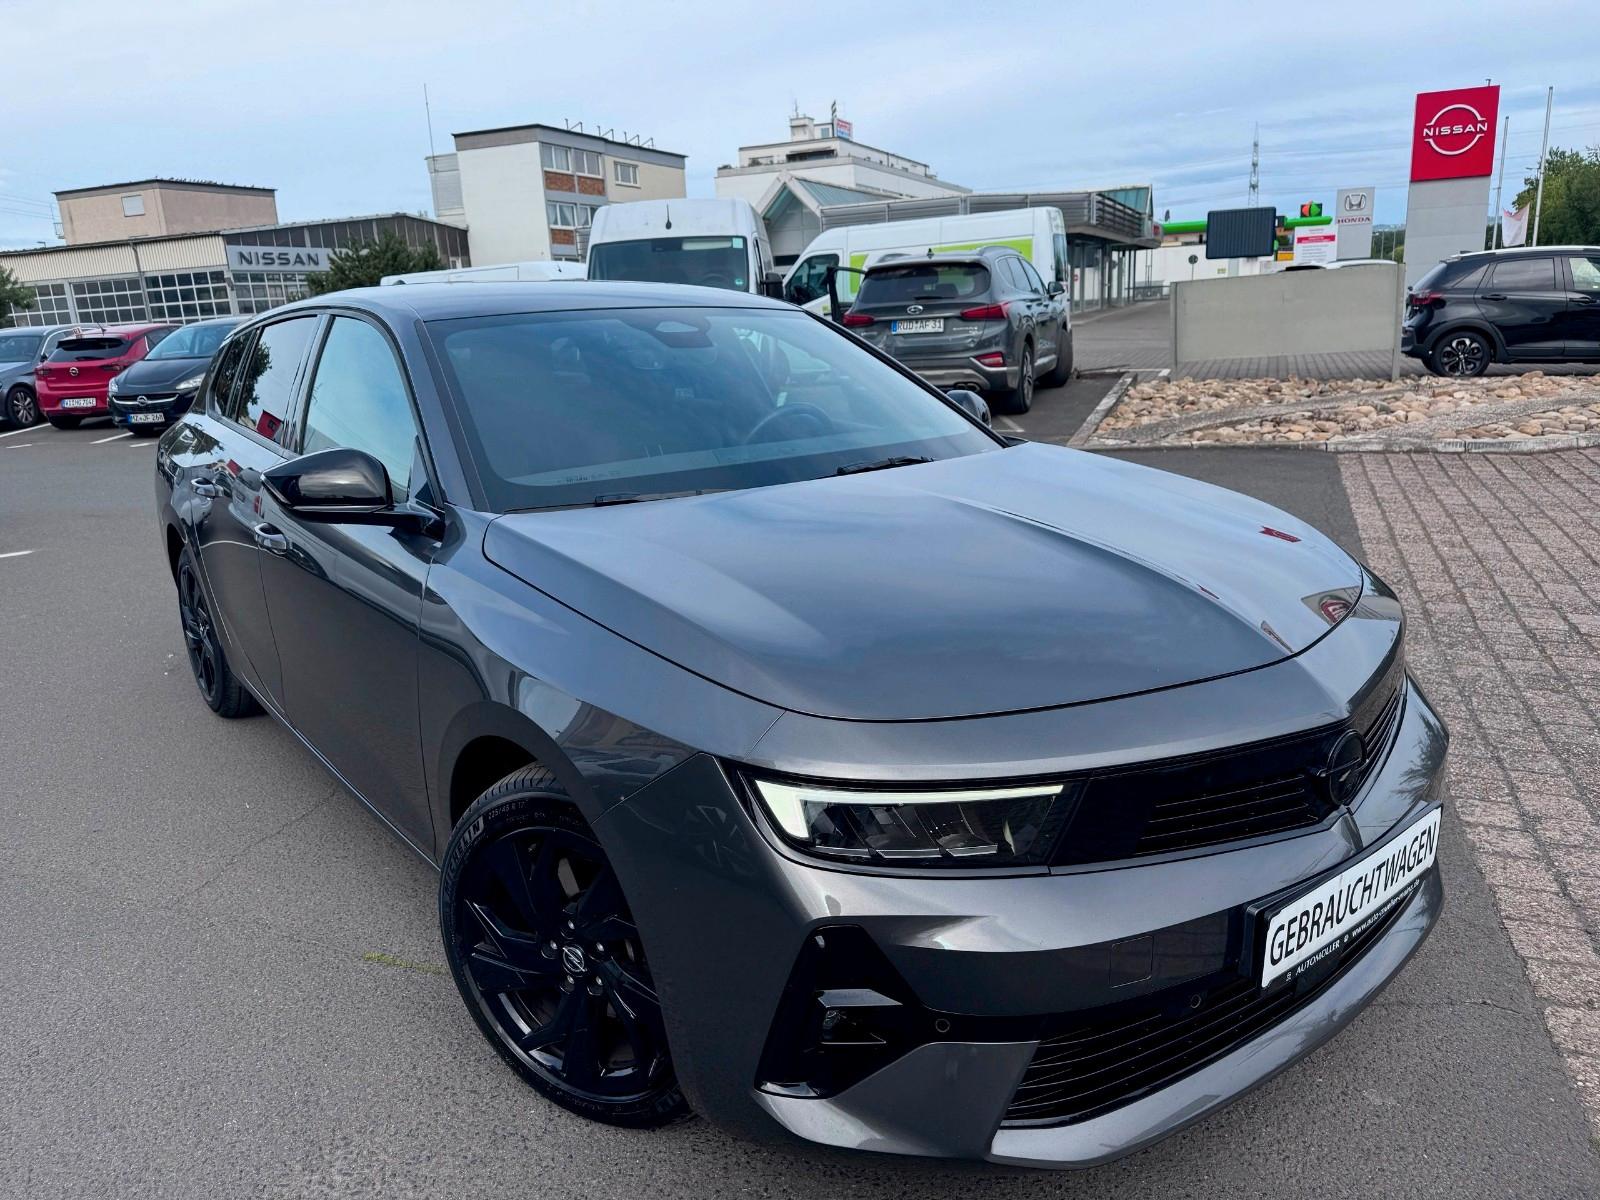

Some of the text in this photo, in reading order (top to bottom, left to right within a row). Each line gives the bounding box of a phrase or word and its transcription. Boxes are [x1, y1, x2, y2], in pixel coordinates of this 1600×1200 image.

[1422, 122, 1488, 137] NISSAN
[1336, 216, 1371, 224] HONDA
[237, 251, 320, 266] NISSAN
[931, 318, 942, 329] 31
[1270, 821, 1437, 966] GEBRAUCHTWAGEN
